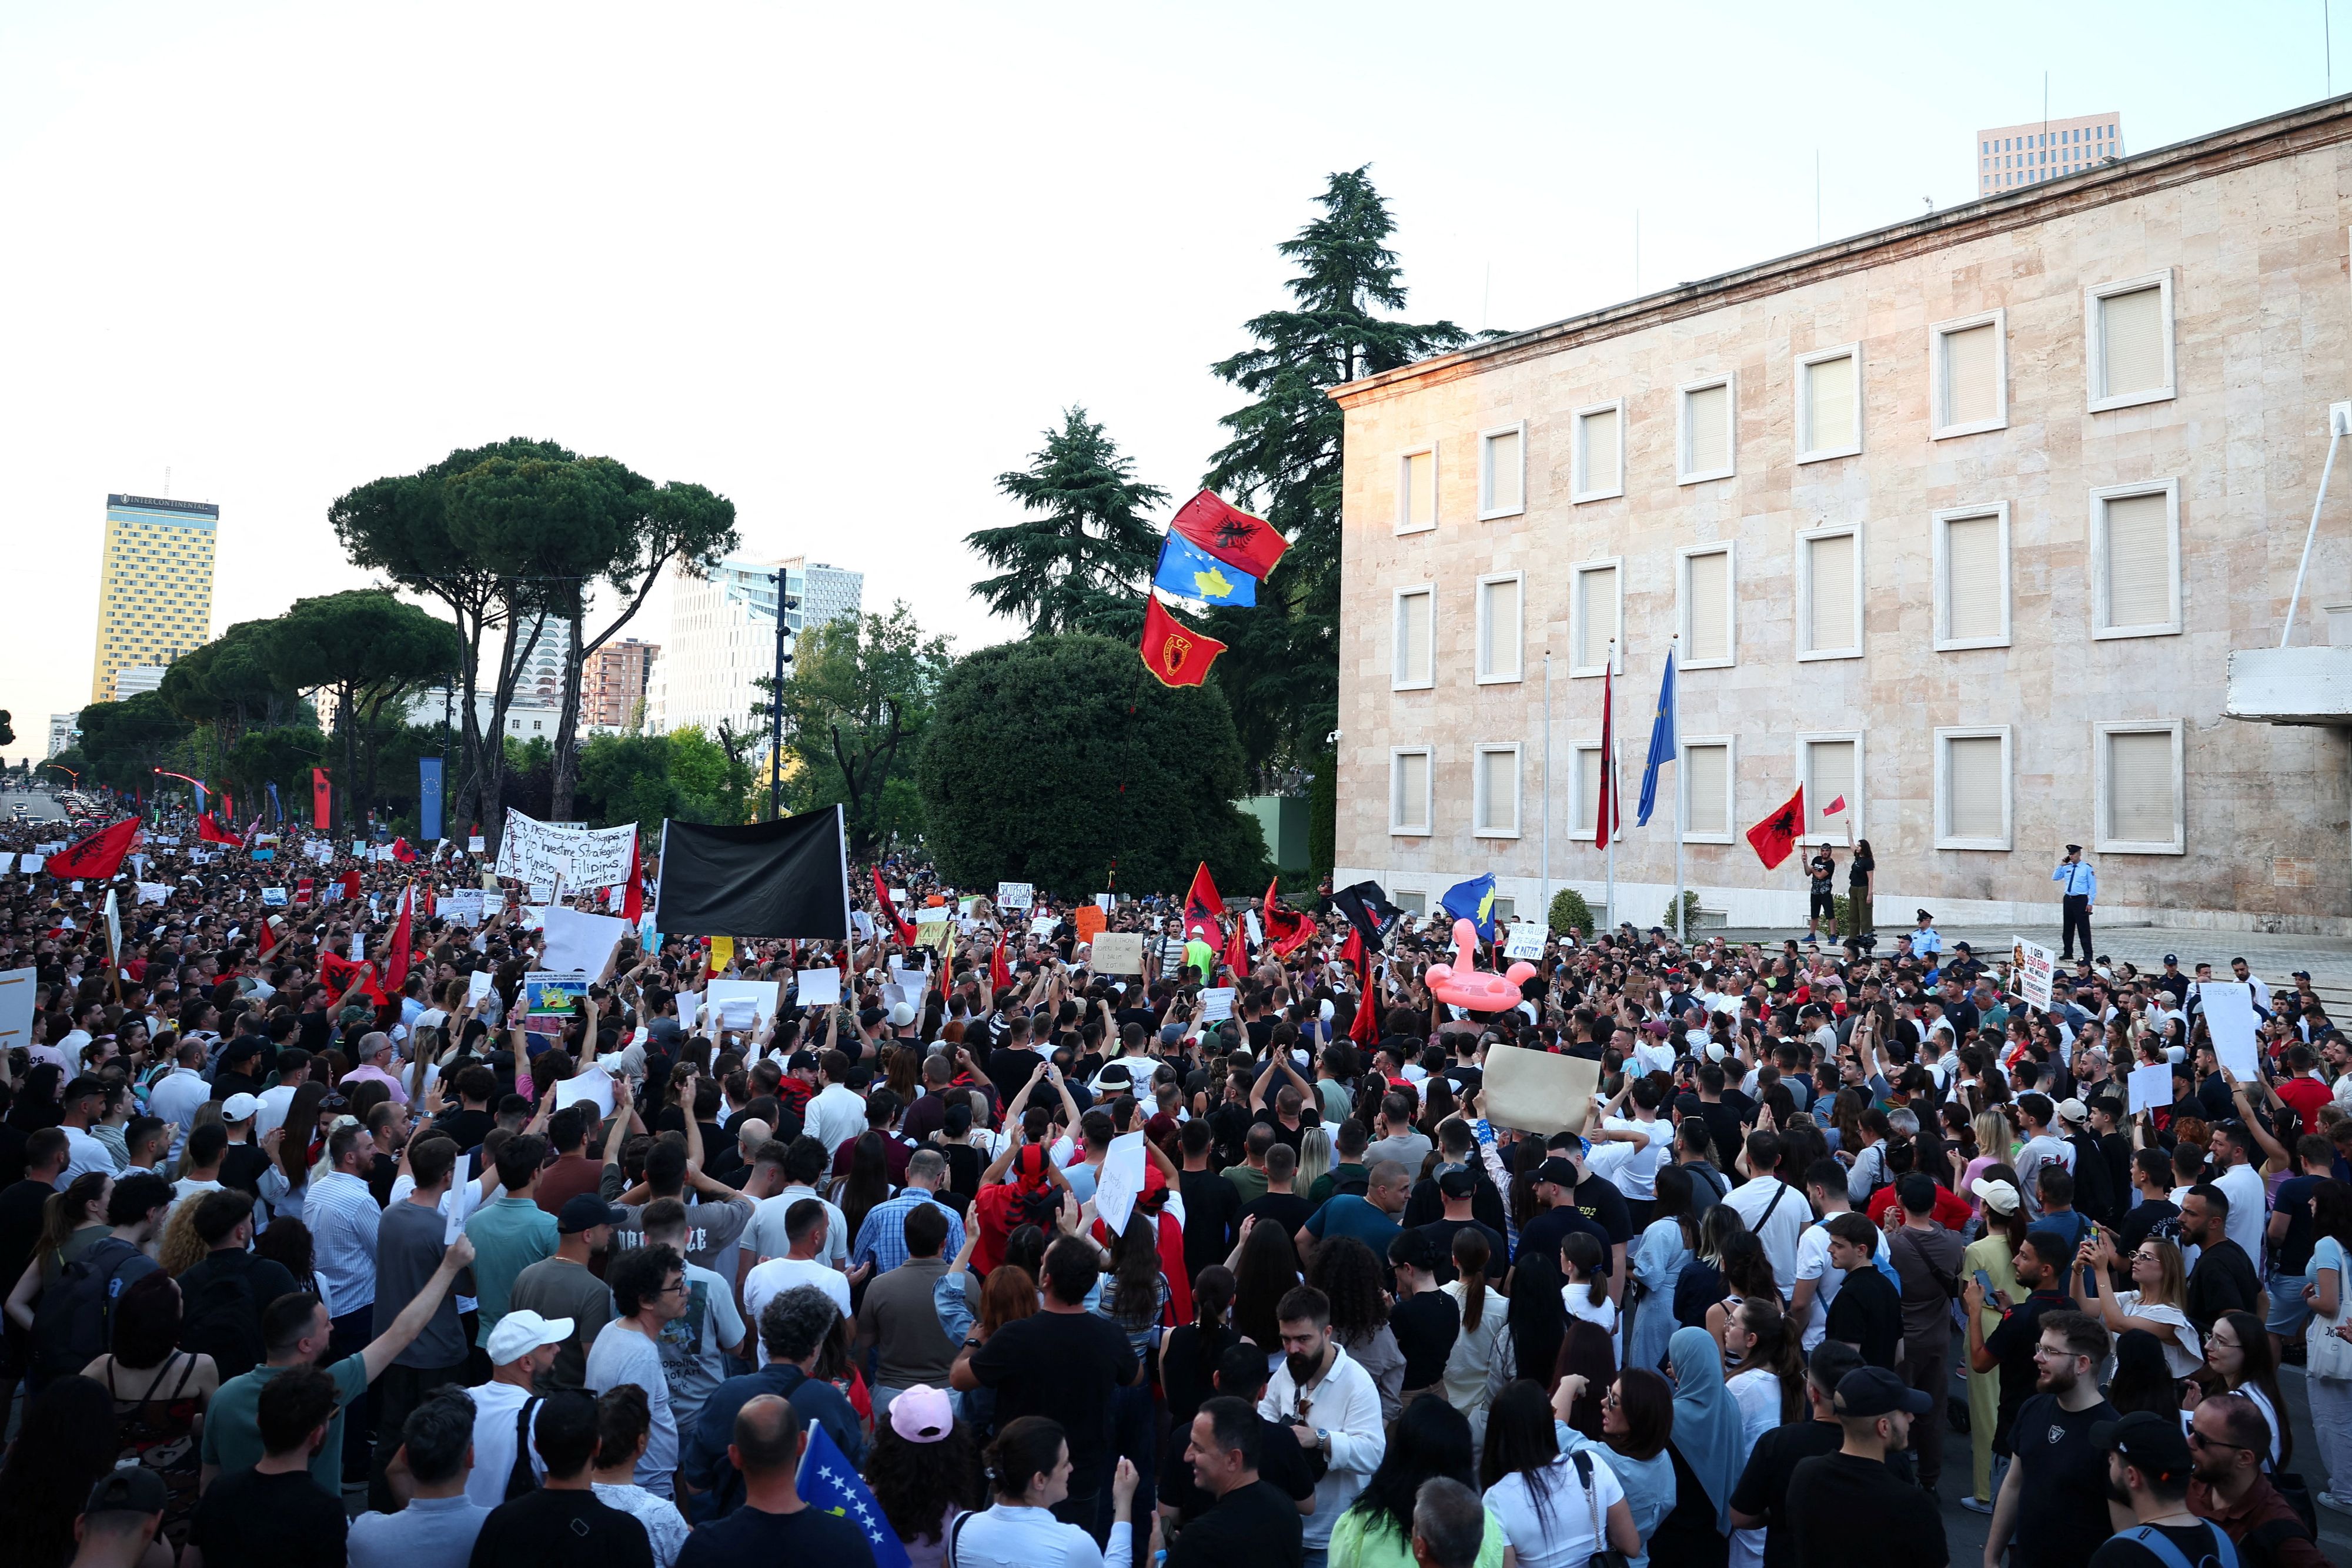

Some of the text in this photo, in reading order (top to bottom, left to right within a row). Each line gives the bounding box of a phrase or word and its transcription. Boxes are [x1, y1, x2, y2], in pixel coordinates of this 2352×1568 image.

[131, 496, 206, 510] INTERCONTINENTAL
[502, 842, 521, 862] Me
[1001, 896, 1029, 906] NUK SHITET
[2030, 947, 2043, 959] 1 QEN
[2027, 955, 2050, 973] 250 EURO
[2035, 969, 2046, 979] MUAJ
[670, 1368, 701, 1380] of Art
